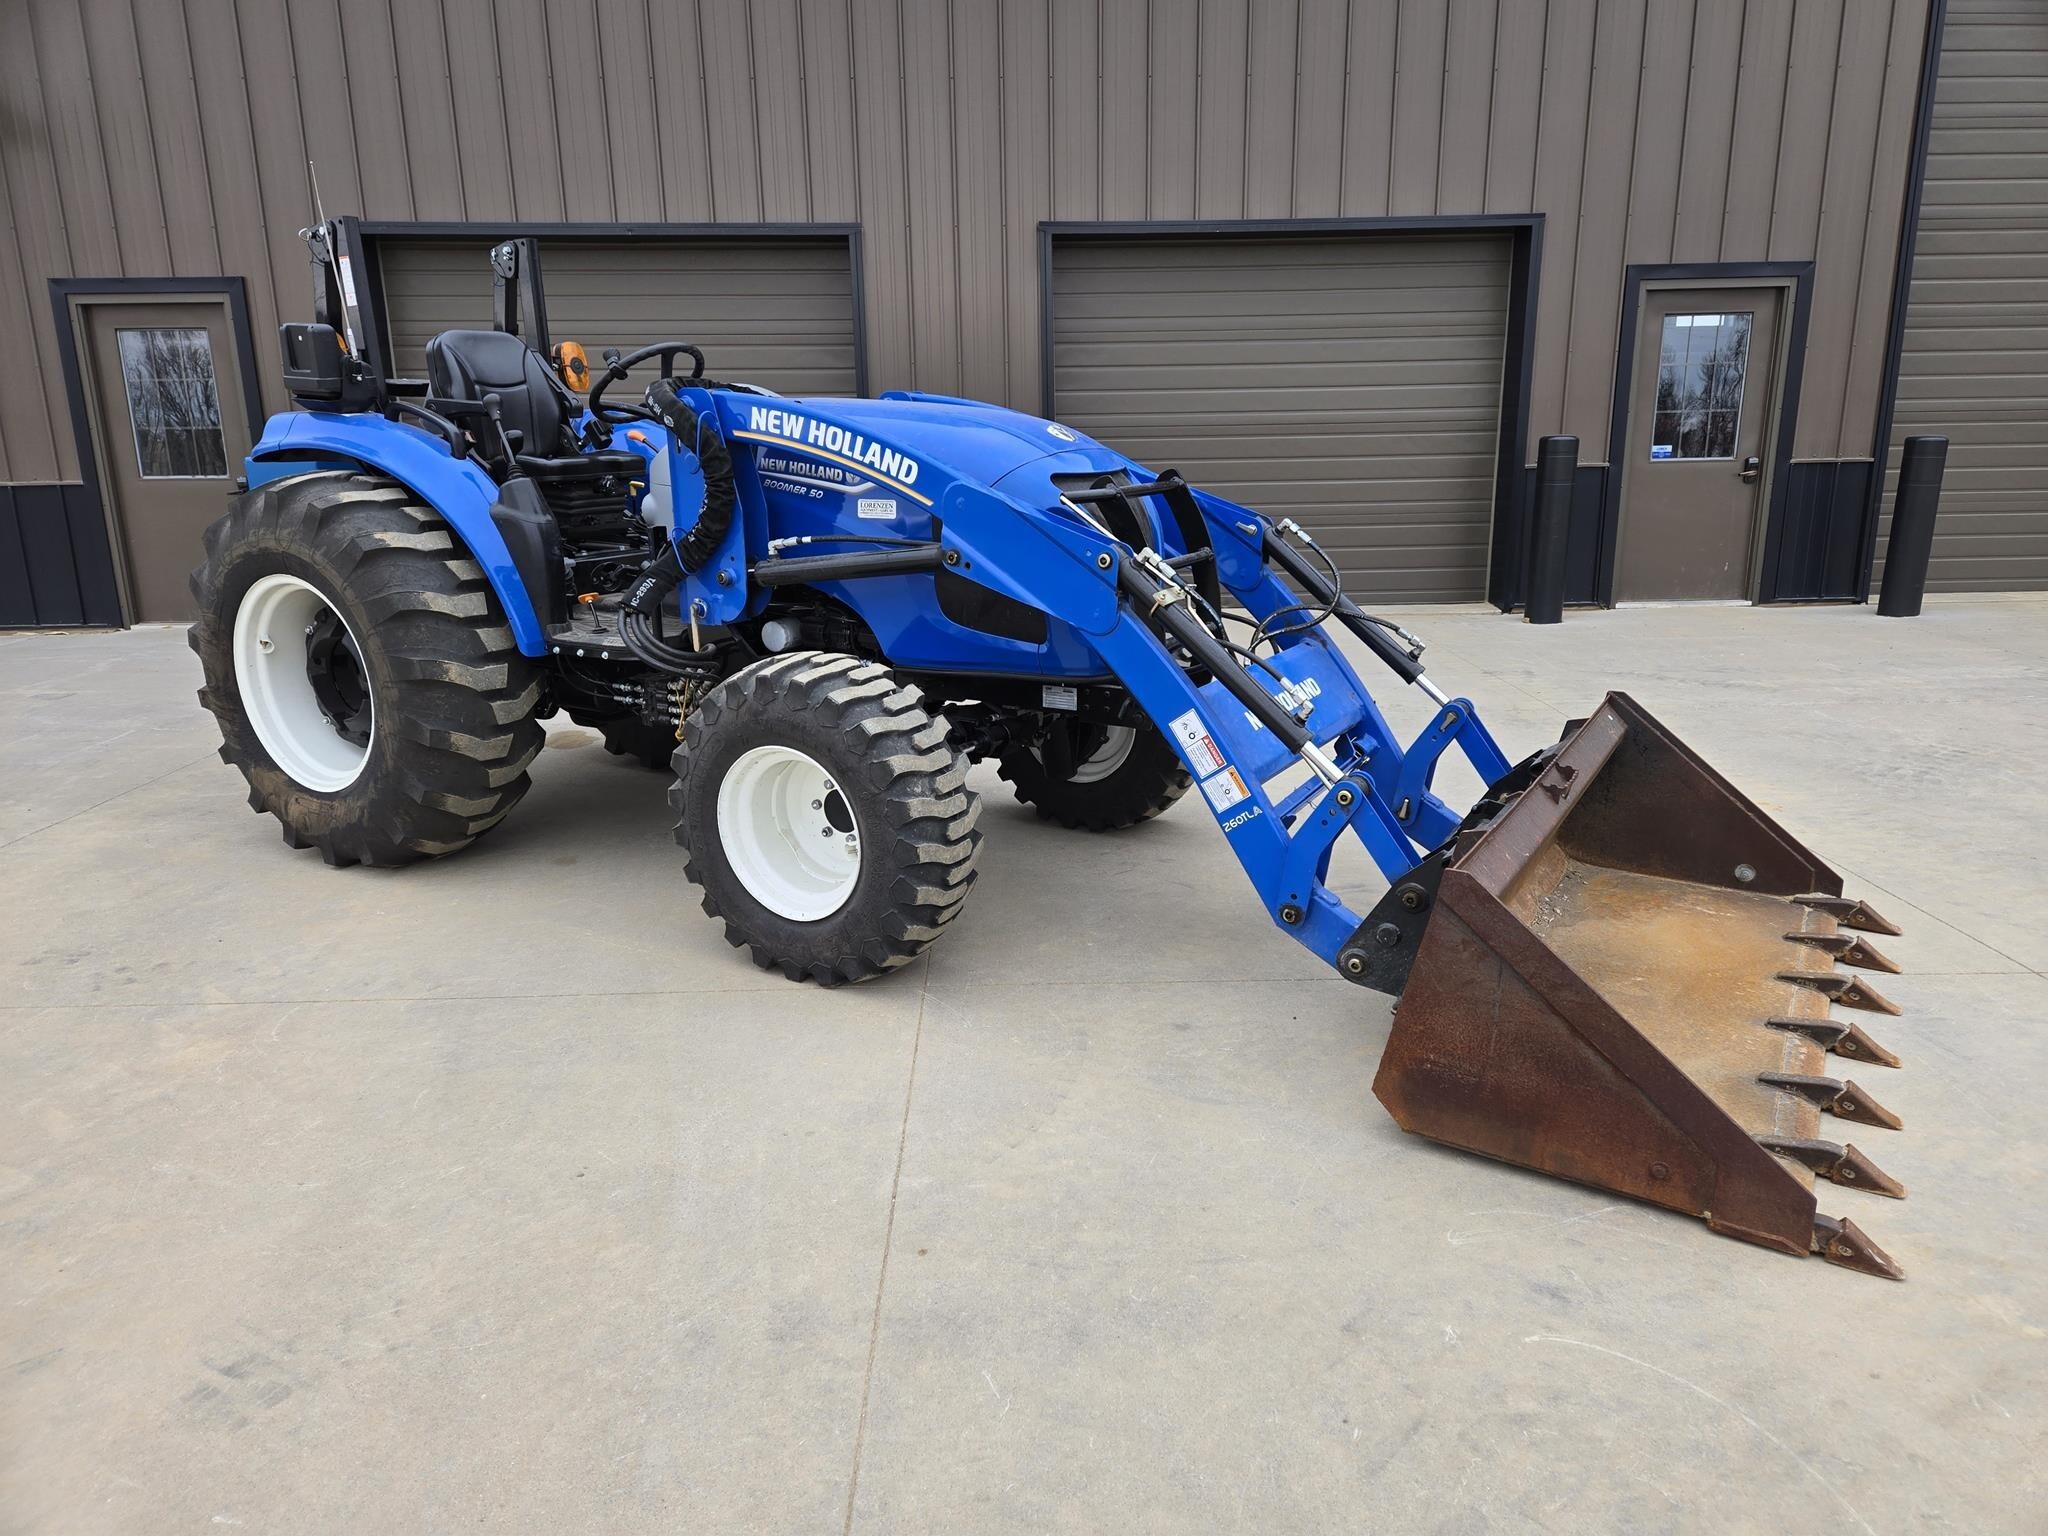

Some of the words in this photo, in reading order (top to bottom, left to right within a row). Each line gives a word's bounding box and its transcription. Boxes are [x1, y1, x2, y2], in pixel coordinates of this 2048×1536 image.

[751, 406, 804, 439] NEW
[808, 419, 918, 484] HOLLAND
[760, 457, 786, 472] NEW
[789, 461, 843, 481] HOLLAND
[763, 479, 807, 495] BOOMER
[808, 489, 824, 499] 50
[1222, 805, 1263, 833] 260TLA
